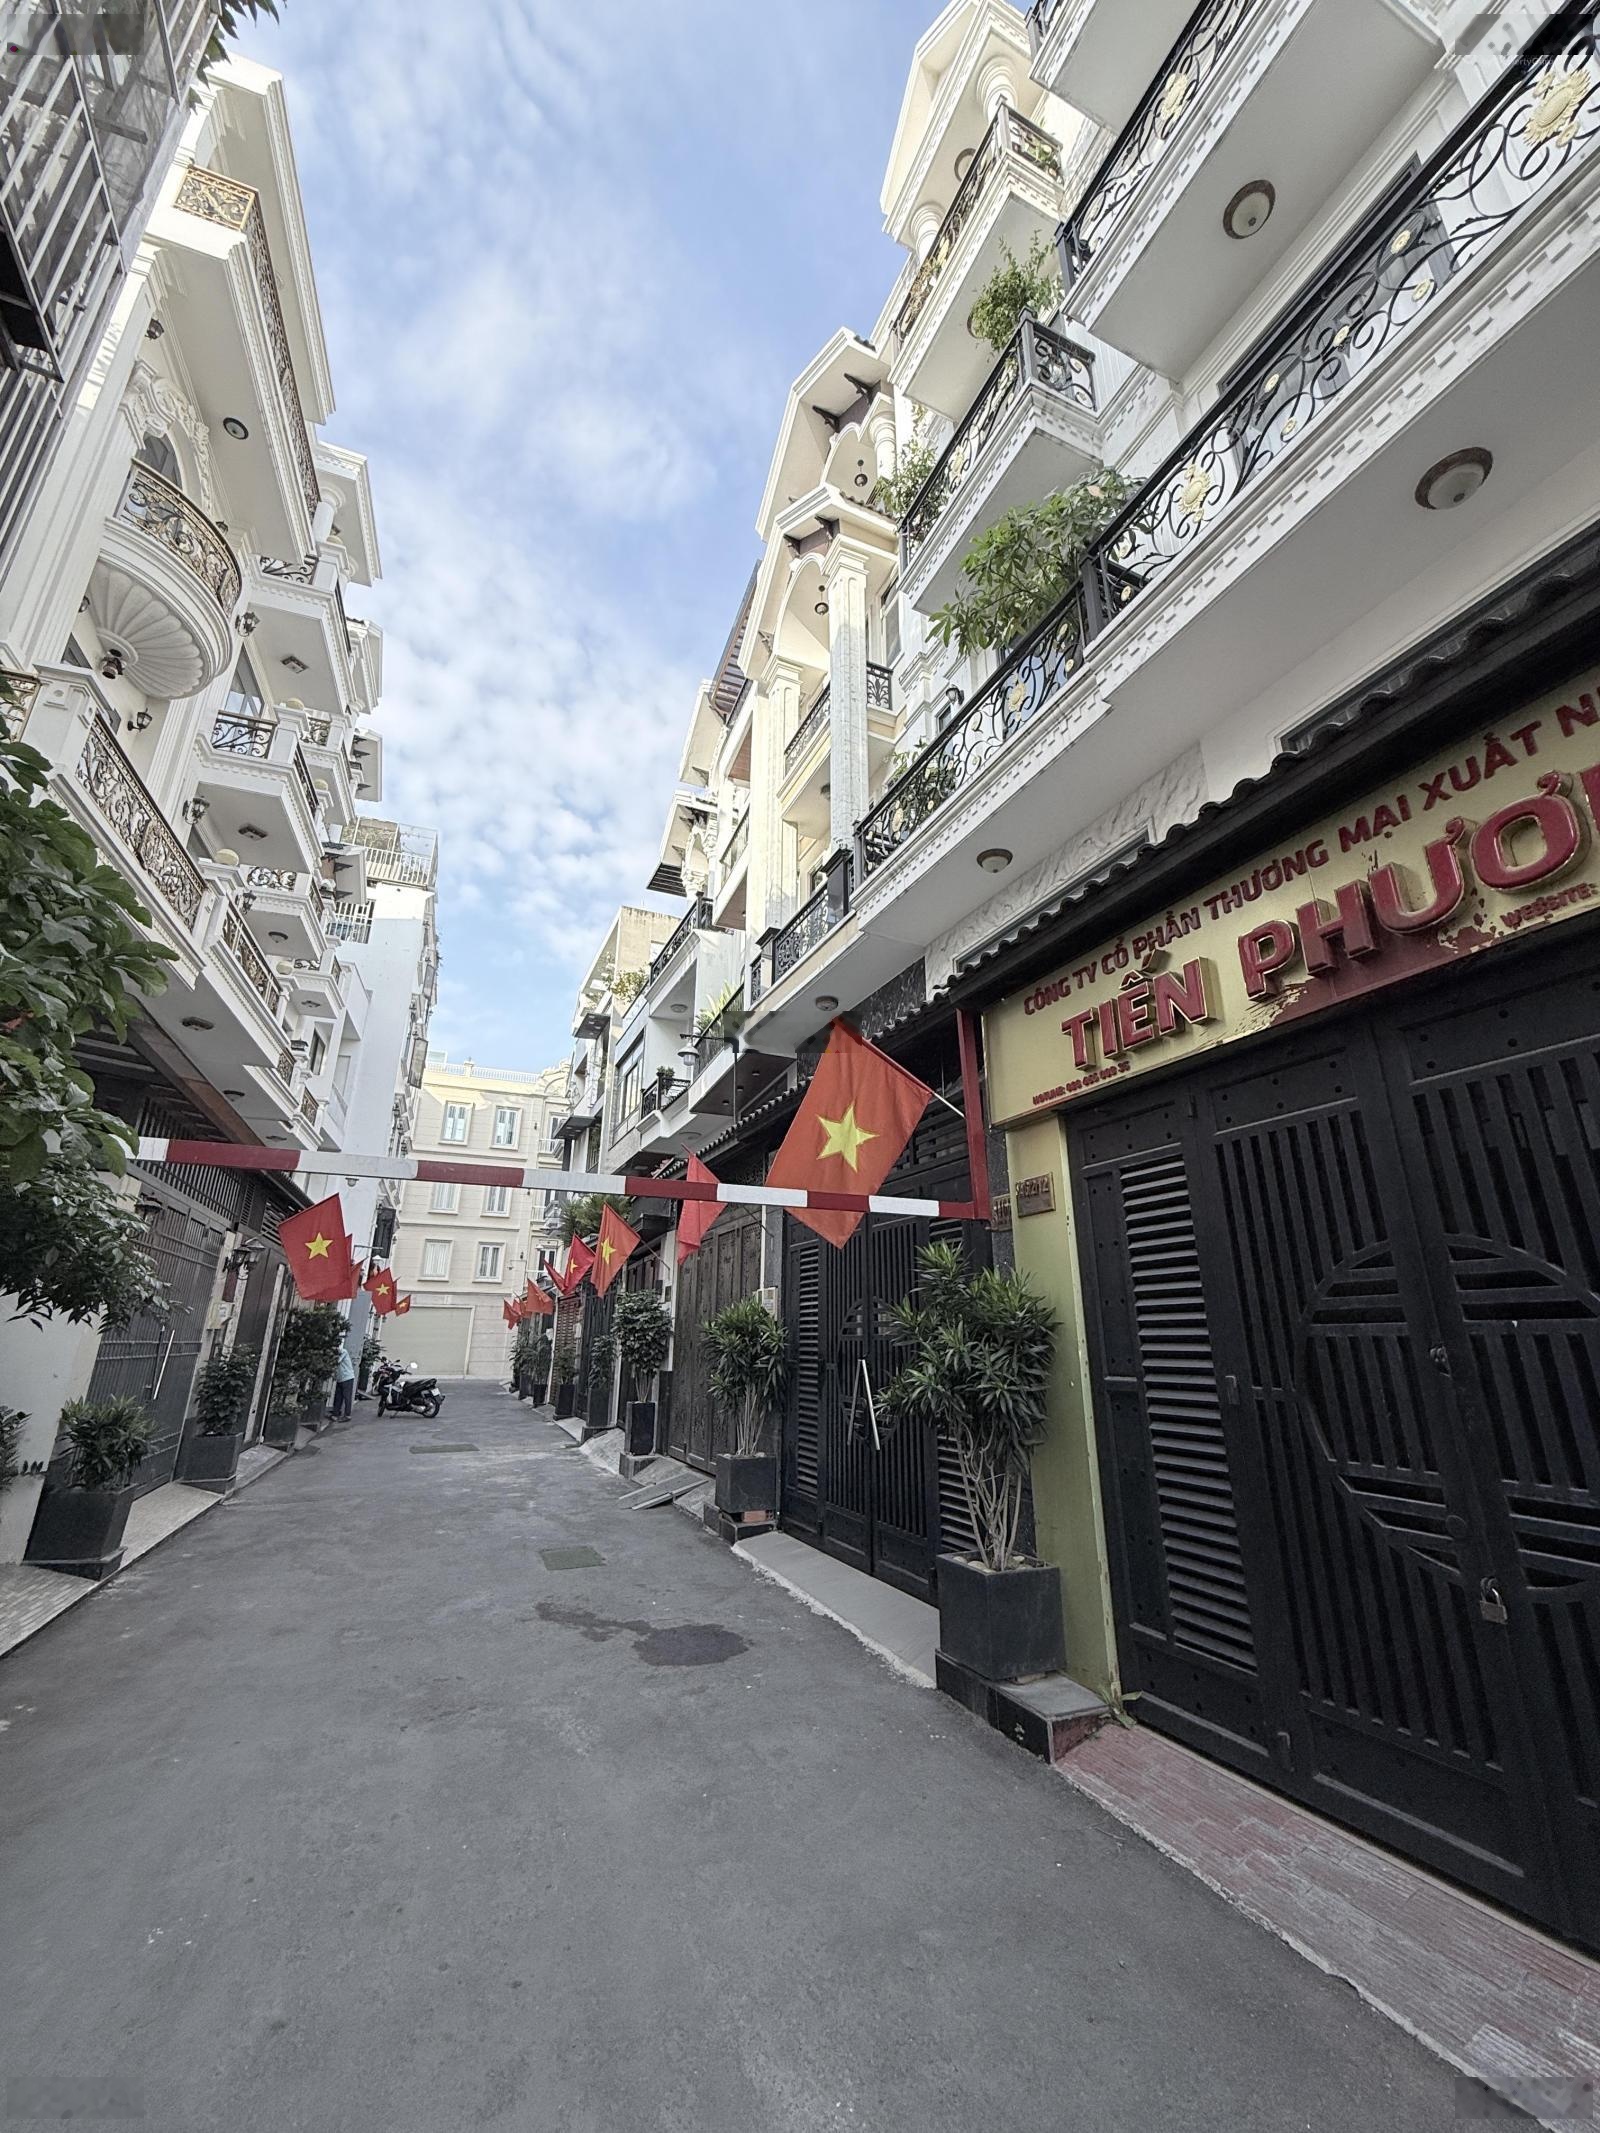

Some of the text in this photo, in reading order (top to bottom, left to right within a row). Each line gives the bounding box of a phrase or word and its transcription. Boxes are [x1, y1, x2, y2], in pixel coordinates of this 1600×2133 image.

[1023, 685, 1600, 1016] CÔNG TY CỔ PHẦN THƯƠNG MẠI XUẤT N
[1061, 949, 1212, 1071] TIẾN
